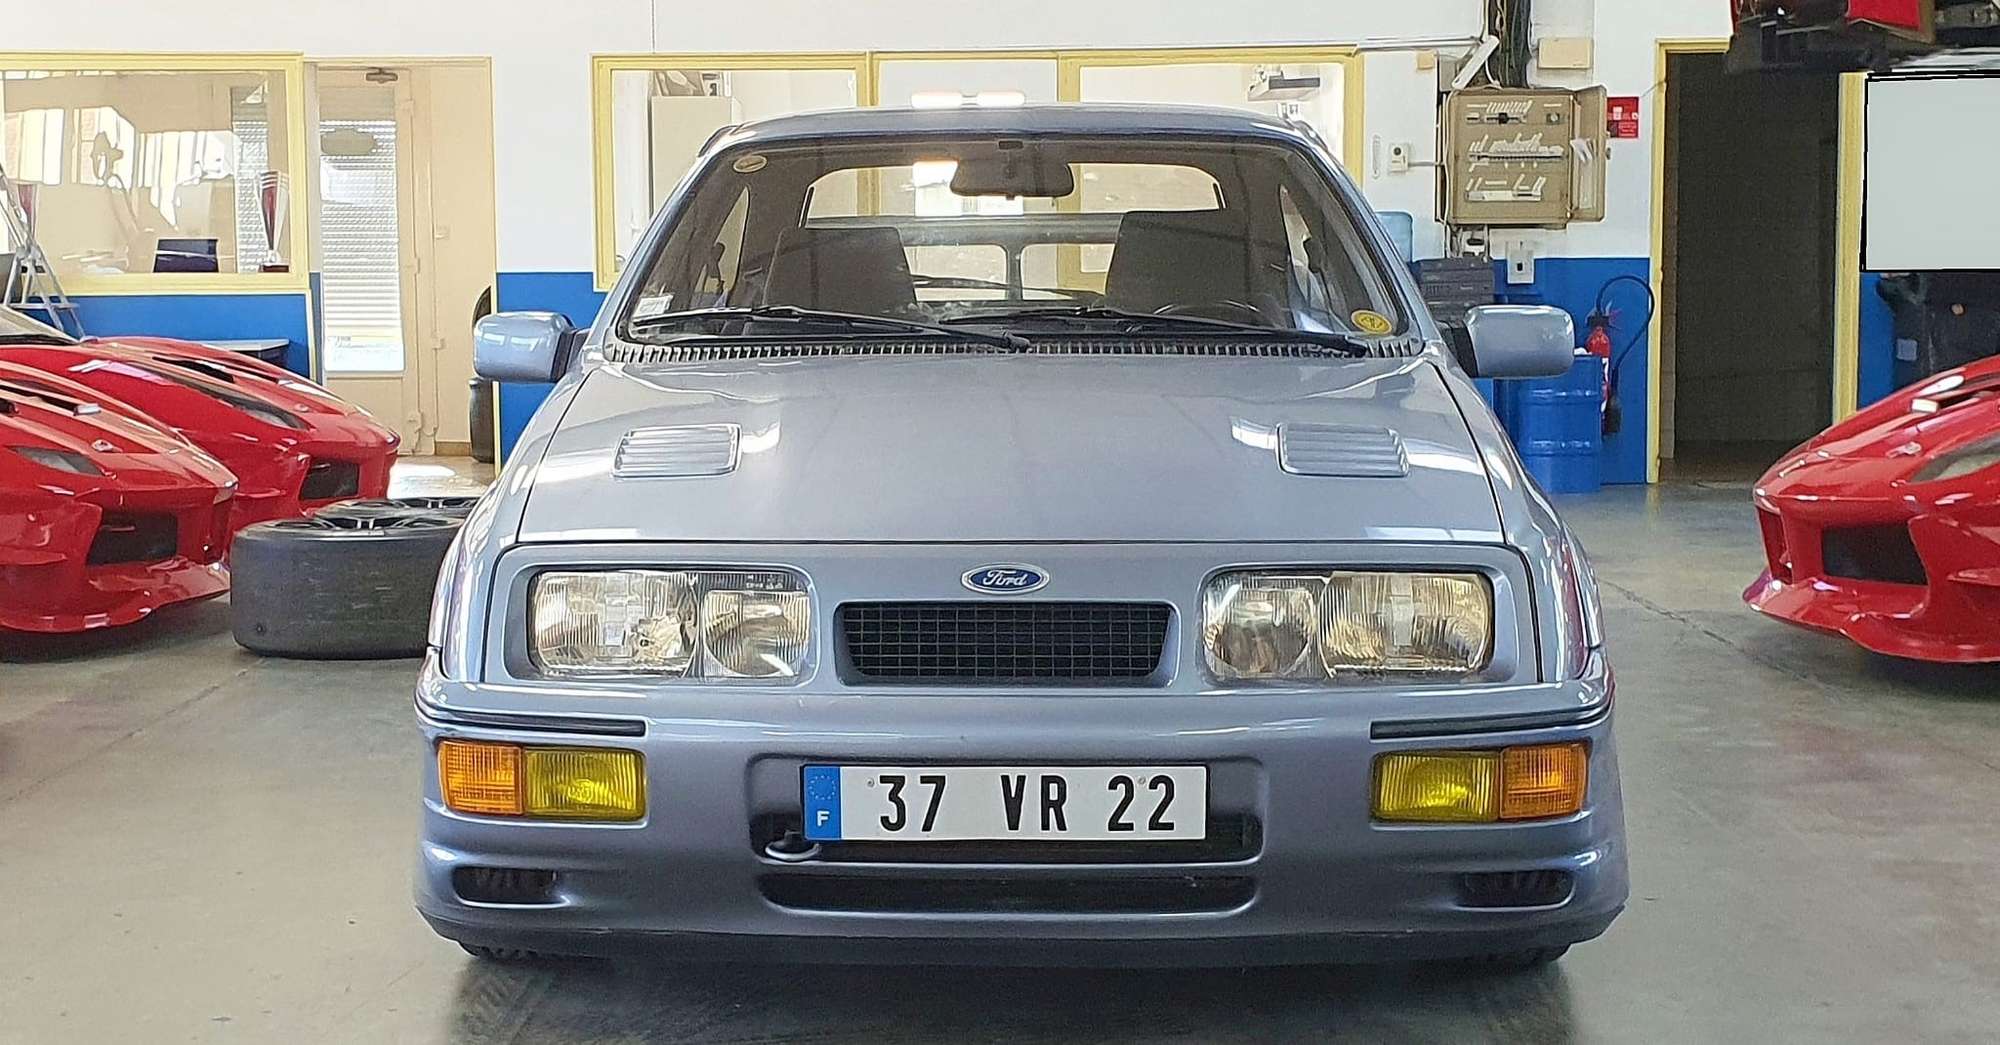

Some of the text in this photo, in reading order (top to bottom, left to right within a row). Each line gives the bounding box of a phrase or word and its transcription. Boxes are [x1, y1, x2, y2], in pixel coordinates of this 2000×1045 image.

[982, 569, 1028, 586] Ford
[879, 774, 1176, 833] 37 VR 22
[816, 811, 829, 827] F
